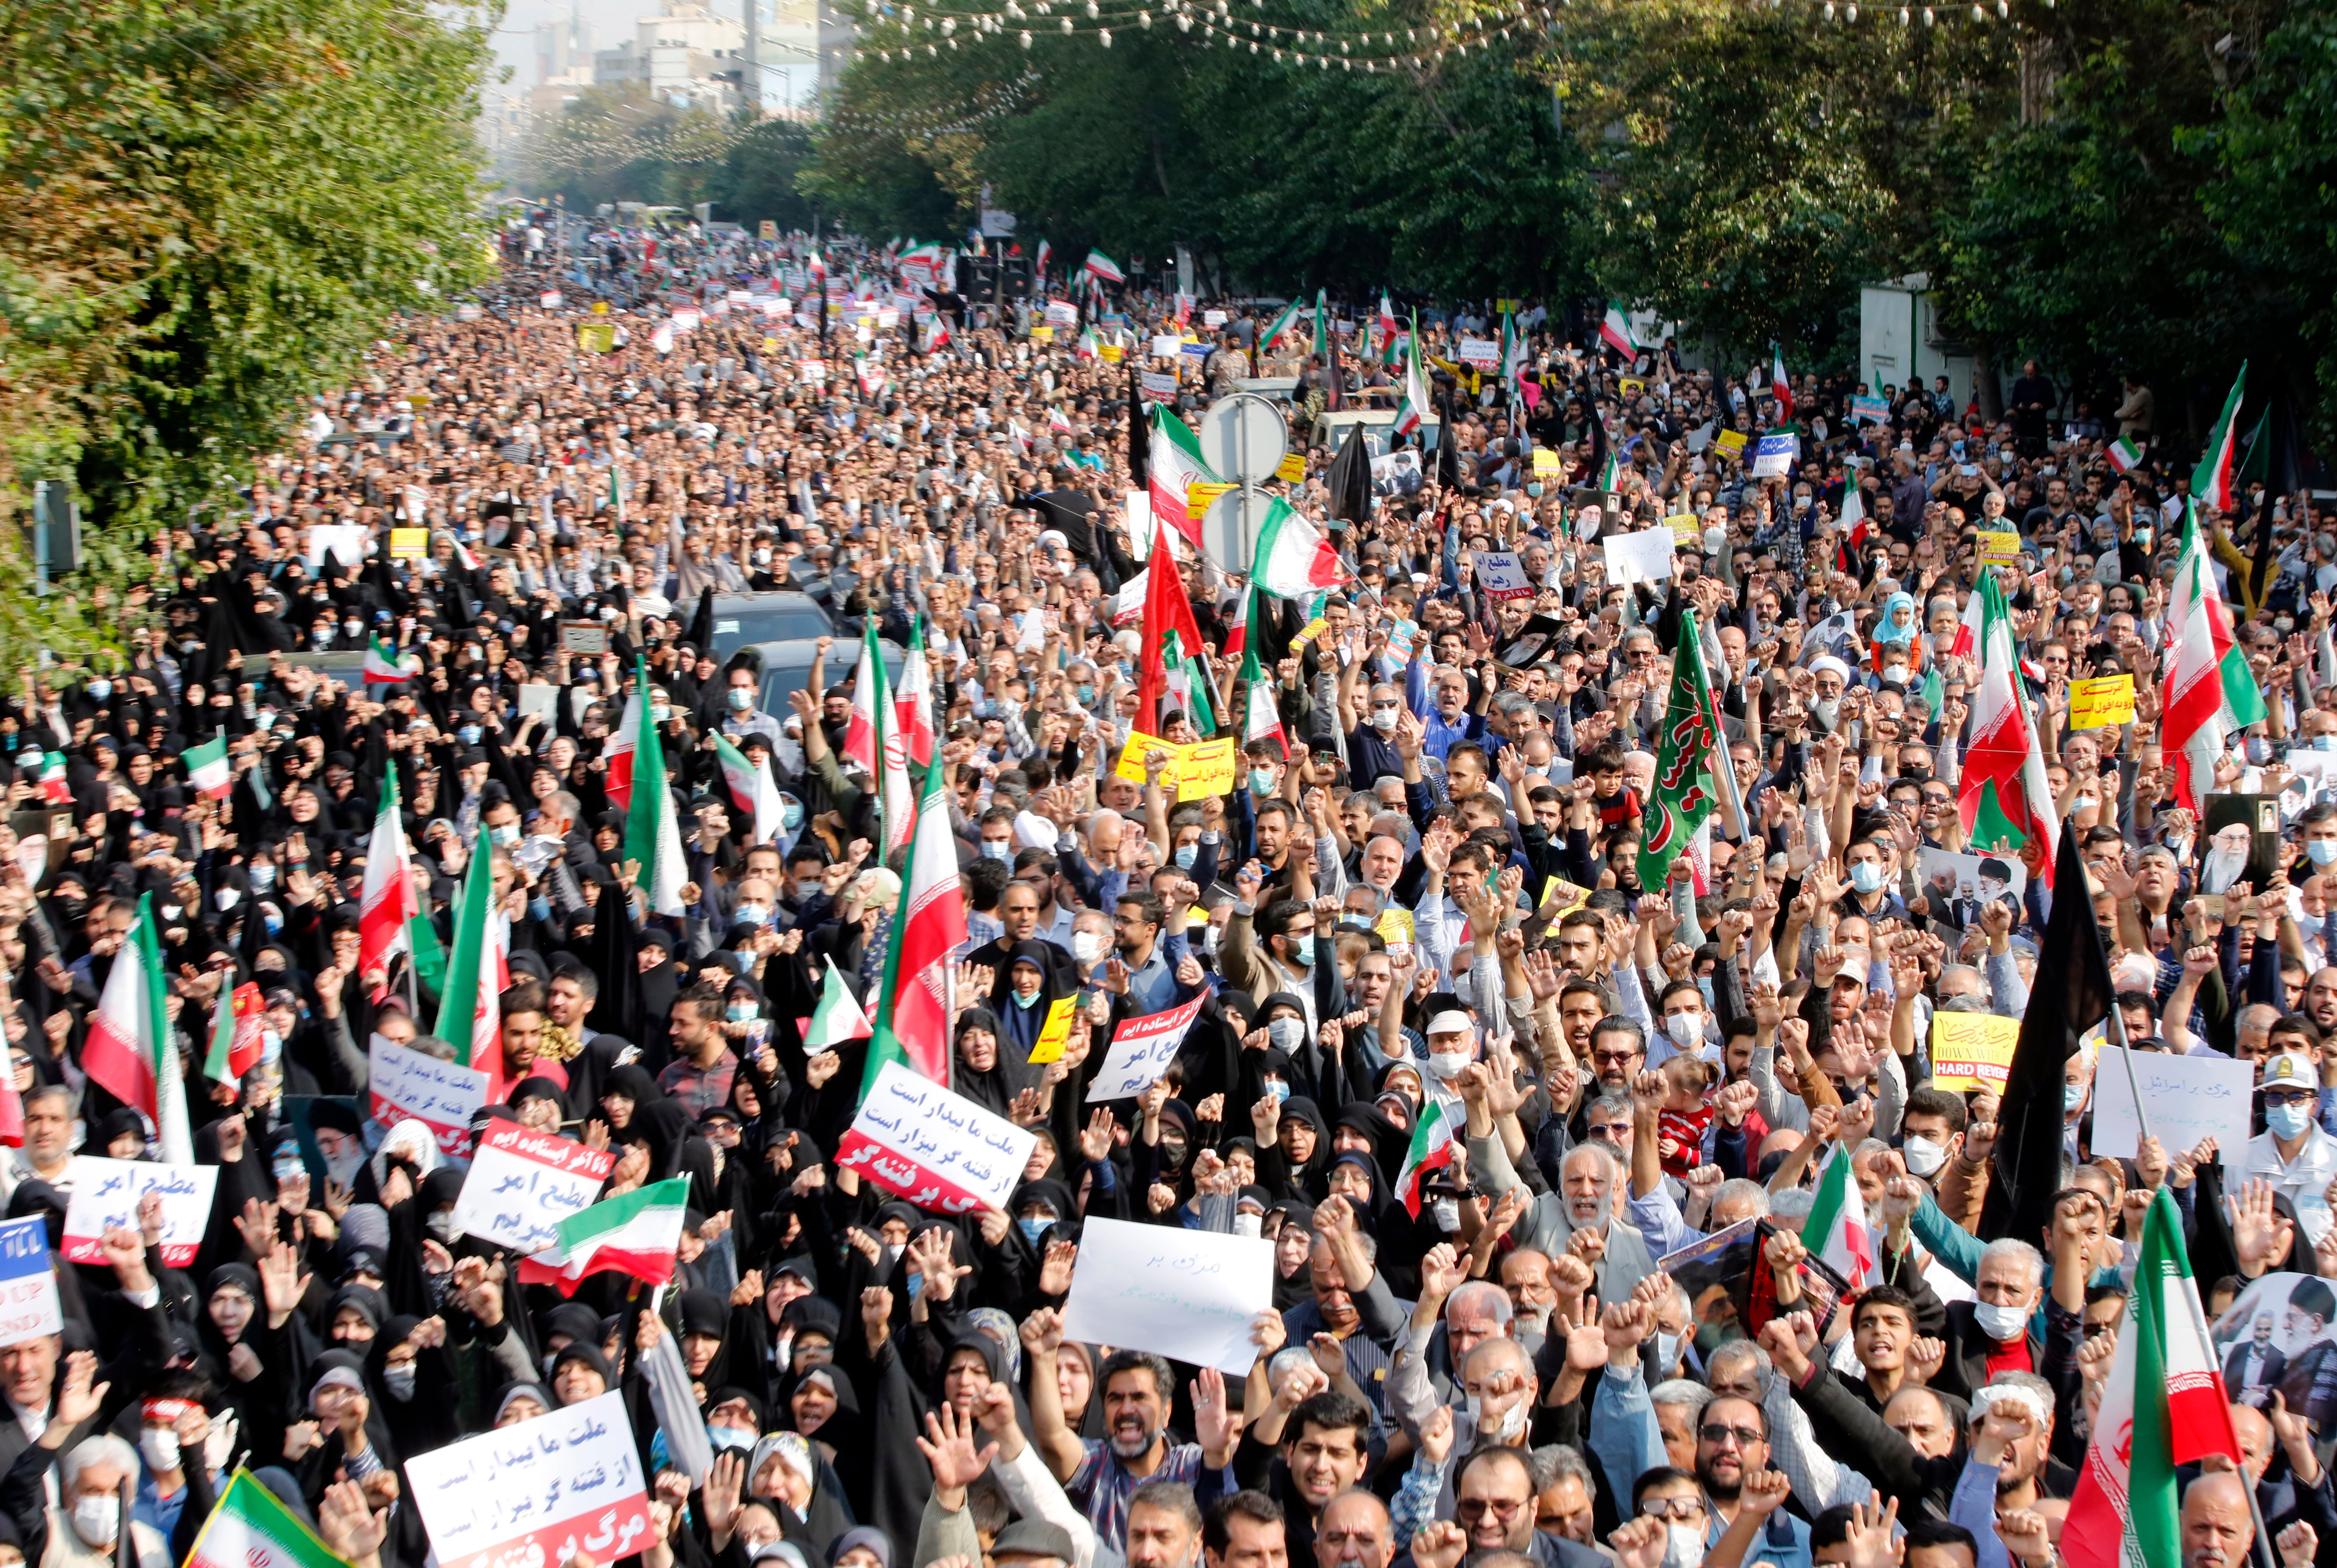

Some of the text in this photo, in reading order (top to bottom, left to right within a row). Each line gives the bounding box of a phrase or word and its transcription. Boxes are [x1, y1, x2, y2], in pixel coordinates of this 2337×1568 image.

[1488, 555, 1511, 571] مطیع
[1387, 645, 1405, 659] DOWN
[2072, 702, 2094, 714] است
[2094, 699, 2115, 714] افول
[1181, 769, 1202, 782] است
[1120, 1020, 1143, 1040] ایم
[1141, 1010, 1180, 1032] ایستاده
[1120, 1028, 1186, 1070] طیع امر
[1937, 1046, 1972, 1059] DOWN
[1976, 1048, 2000, 1062] WITH
[1936, 1062, 2010, 1080] HARD REVENG
[890, 1082, 1015, 1156] ملت ما بیدار است
[491, 1129, 522, 1149] ایم
[516, 1136, 571, 1166] ایستاده
[865, 1107, 1011, 1194] از فتنه گر بیزار است
[93, 1167, 136, 1197] امر
[491, 1170, 541, 1195] امر
[909, 1186, 941, 1207] بر
[1146, 1253, 1221, 1275] مرگ بر
[10, 1281, 44, 1303] UP
[566, 1416, 608, 1446] ملت
[538, 1432, 561, 1454] ما
[487, 1449, 535, 1482] بیدار
[570, 1461, 607, 1492] فتنه
[613, 1452, 632, 1488] از
[543, 1476, 562, 1513] گر
[583, 1508, 646, 1556] مرگ
